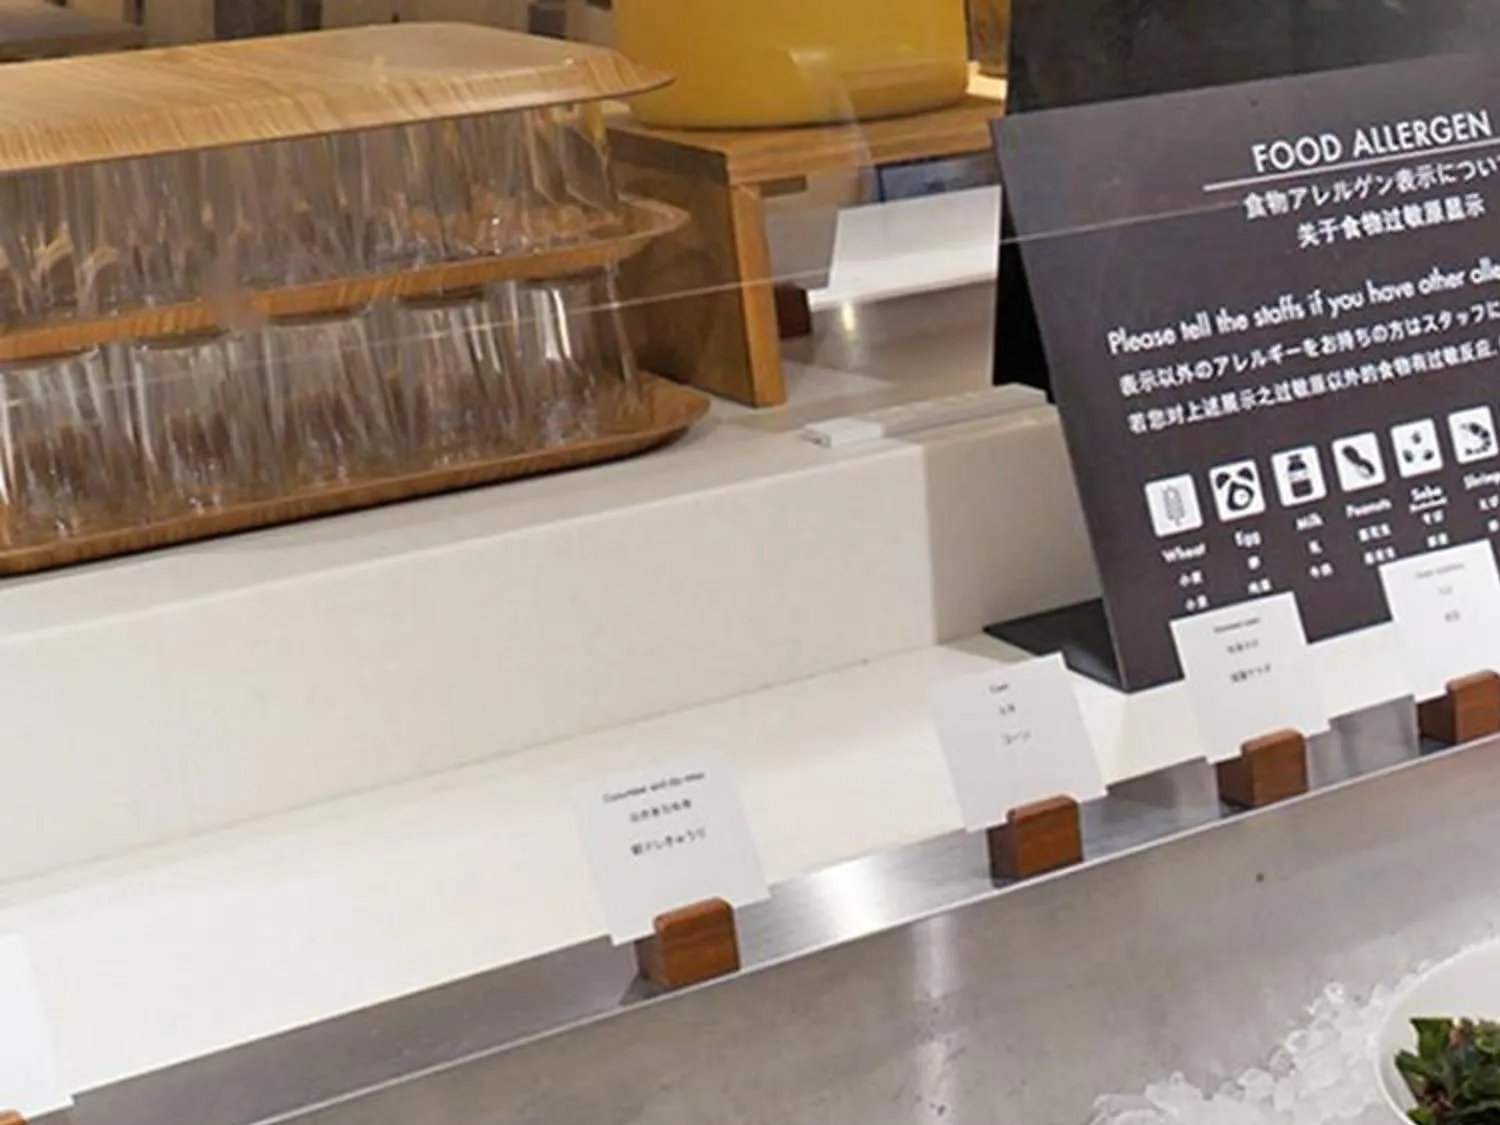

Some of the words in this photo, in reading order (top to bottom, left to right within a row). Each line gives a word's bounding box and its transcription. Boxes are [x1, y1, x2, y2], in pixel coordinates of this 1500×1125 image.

[1251, 133, 1342, 173] FOOD
[1352, 109, 1492, 158] ALLERGEN
[1107, 326, 1177, 355] Please
[1180, 311, 1212, 341] tell
[1215, 307, 1249, 334] the
[1254, 294, 1306, 328] staffs
[1309, 289, 1326, 316] if
[1326, 291, 1364, 318] you
[1365, 279, 1416, 303] have
[1418, 267, 1465, 295] other
[1161, 542, 1206, 563] Wheat
[1234, 530, 1261, 548] Egg
